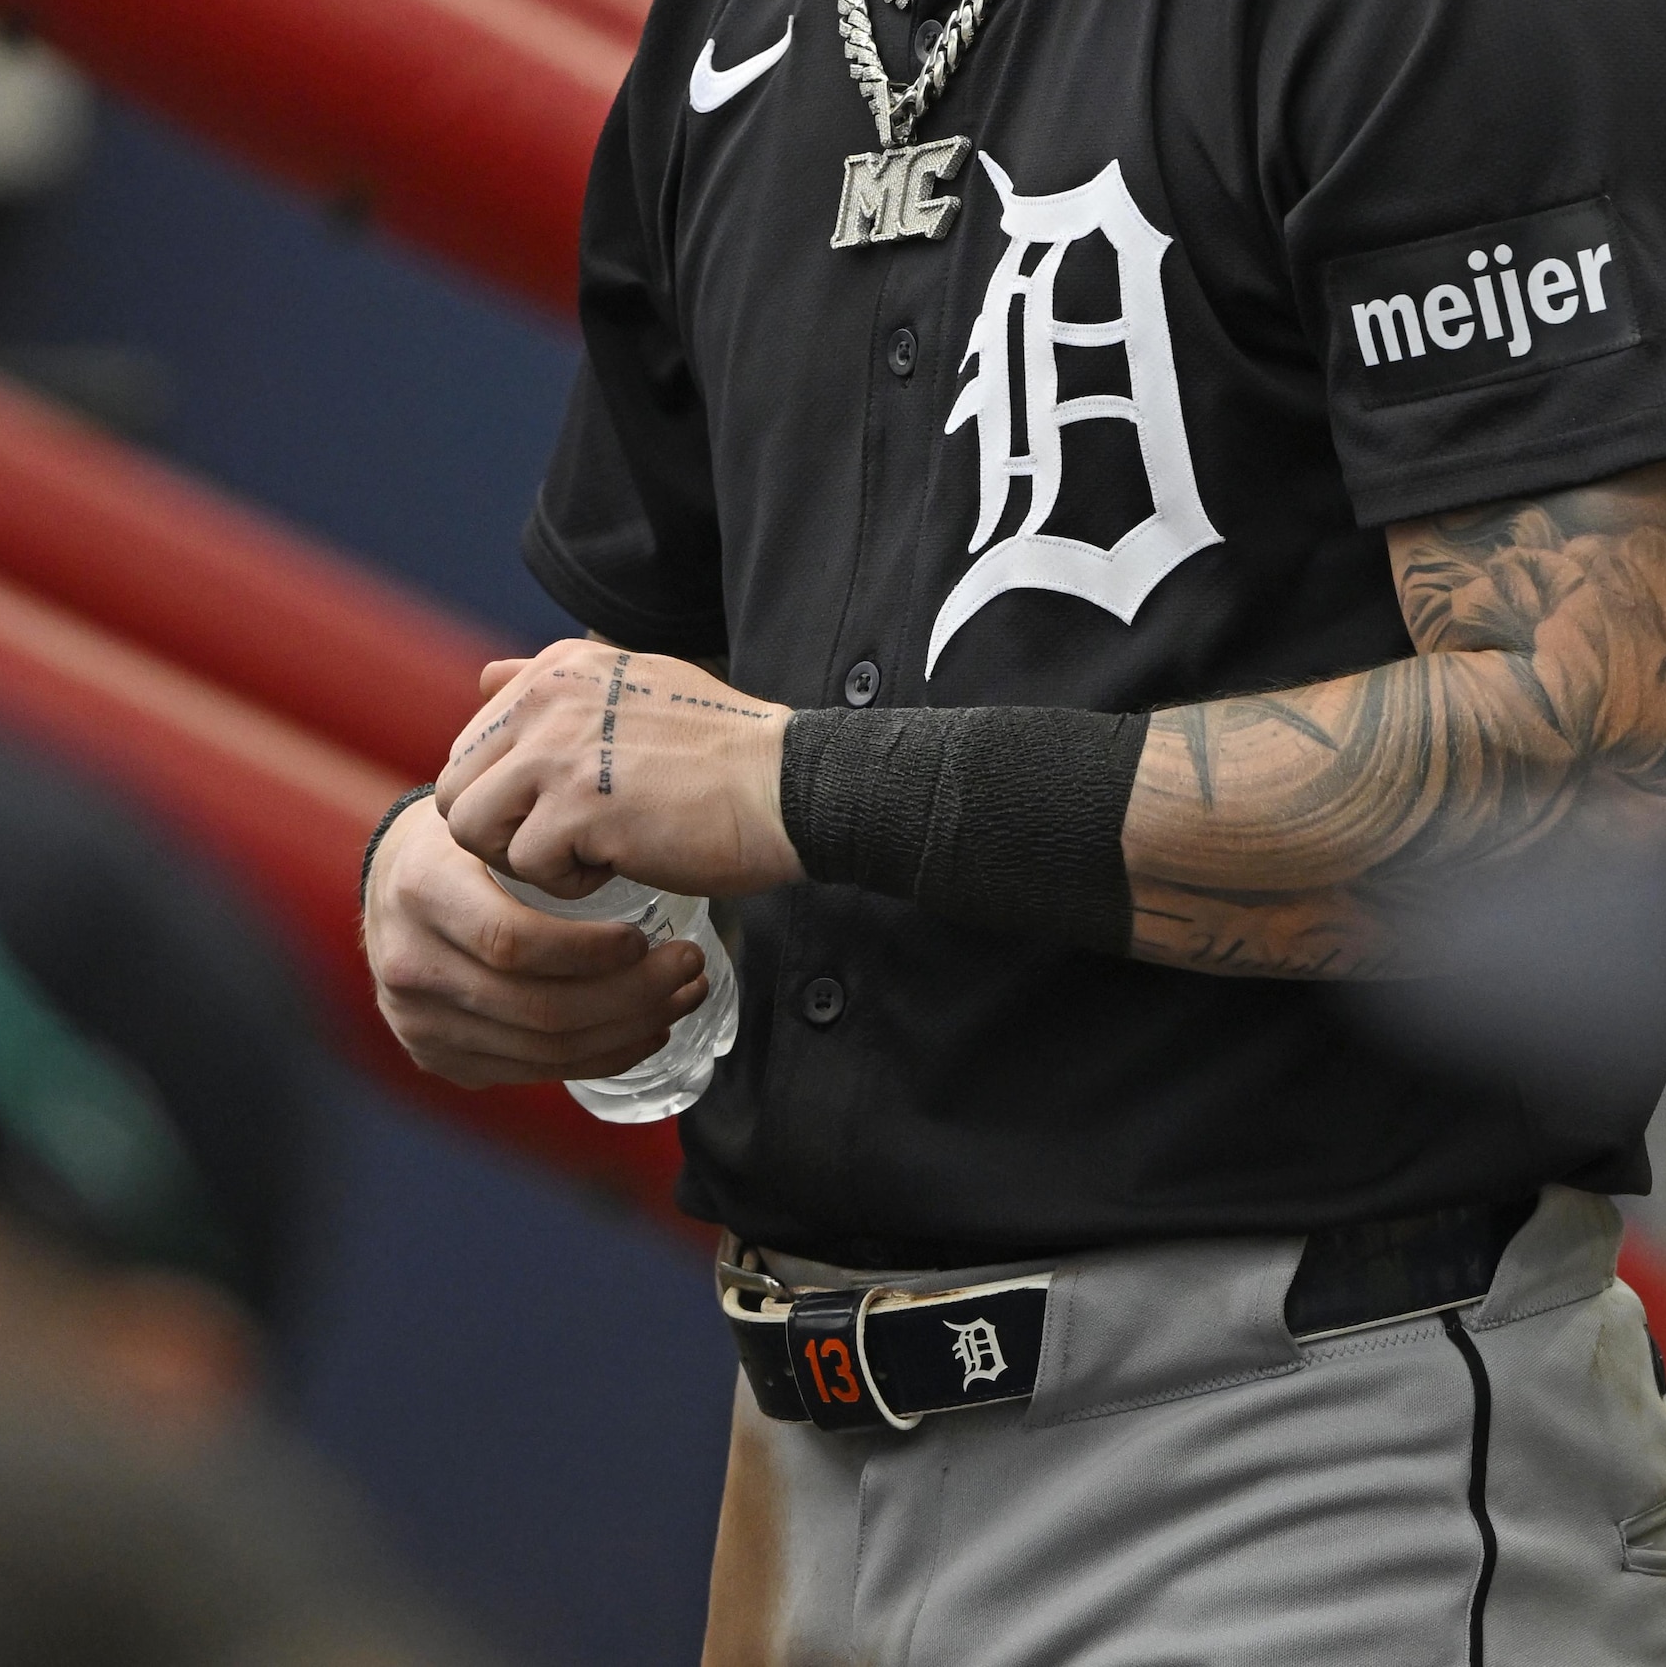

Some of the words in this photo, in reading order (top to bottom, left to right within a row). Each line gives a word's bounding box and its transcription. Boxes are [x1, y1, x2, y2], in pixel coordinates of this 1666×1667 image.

[831, 135, 972, 248] MC
[1351, 243, 1612, 367] meijer
[926, 150, 1225, 681] D
[804, 1338, 861, 1404] 13
[942, 1316, 1009, 1393] D
